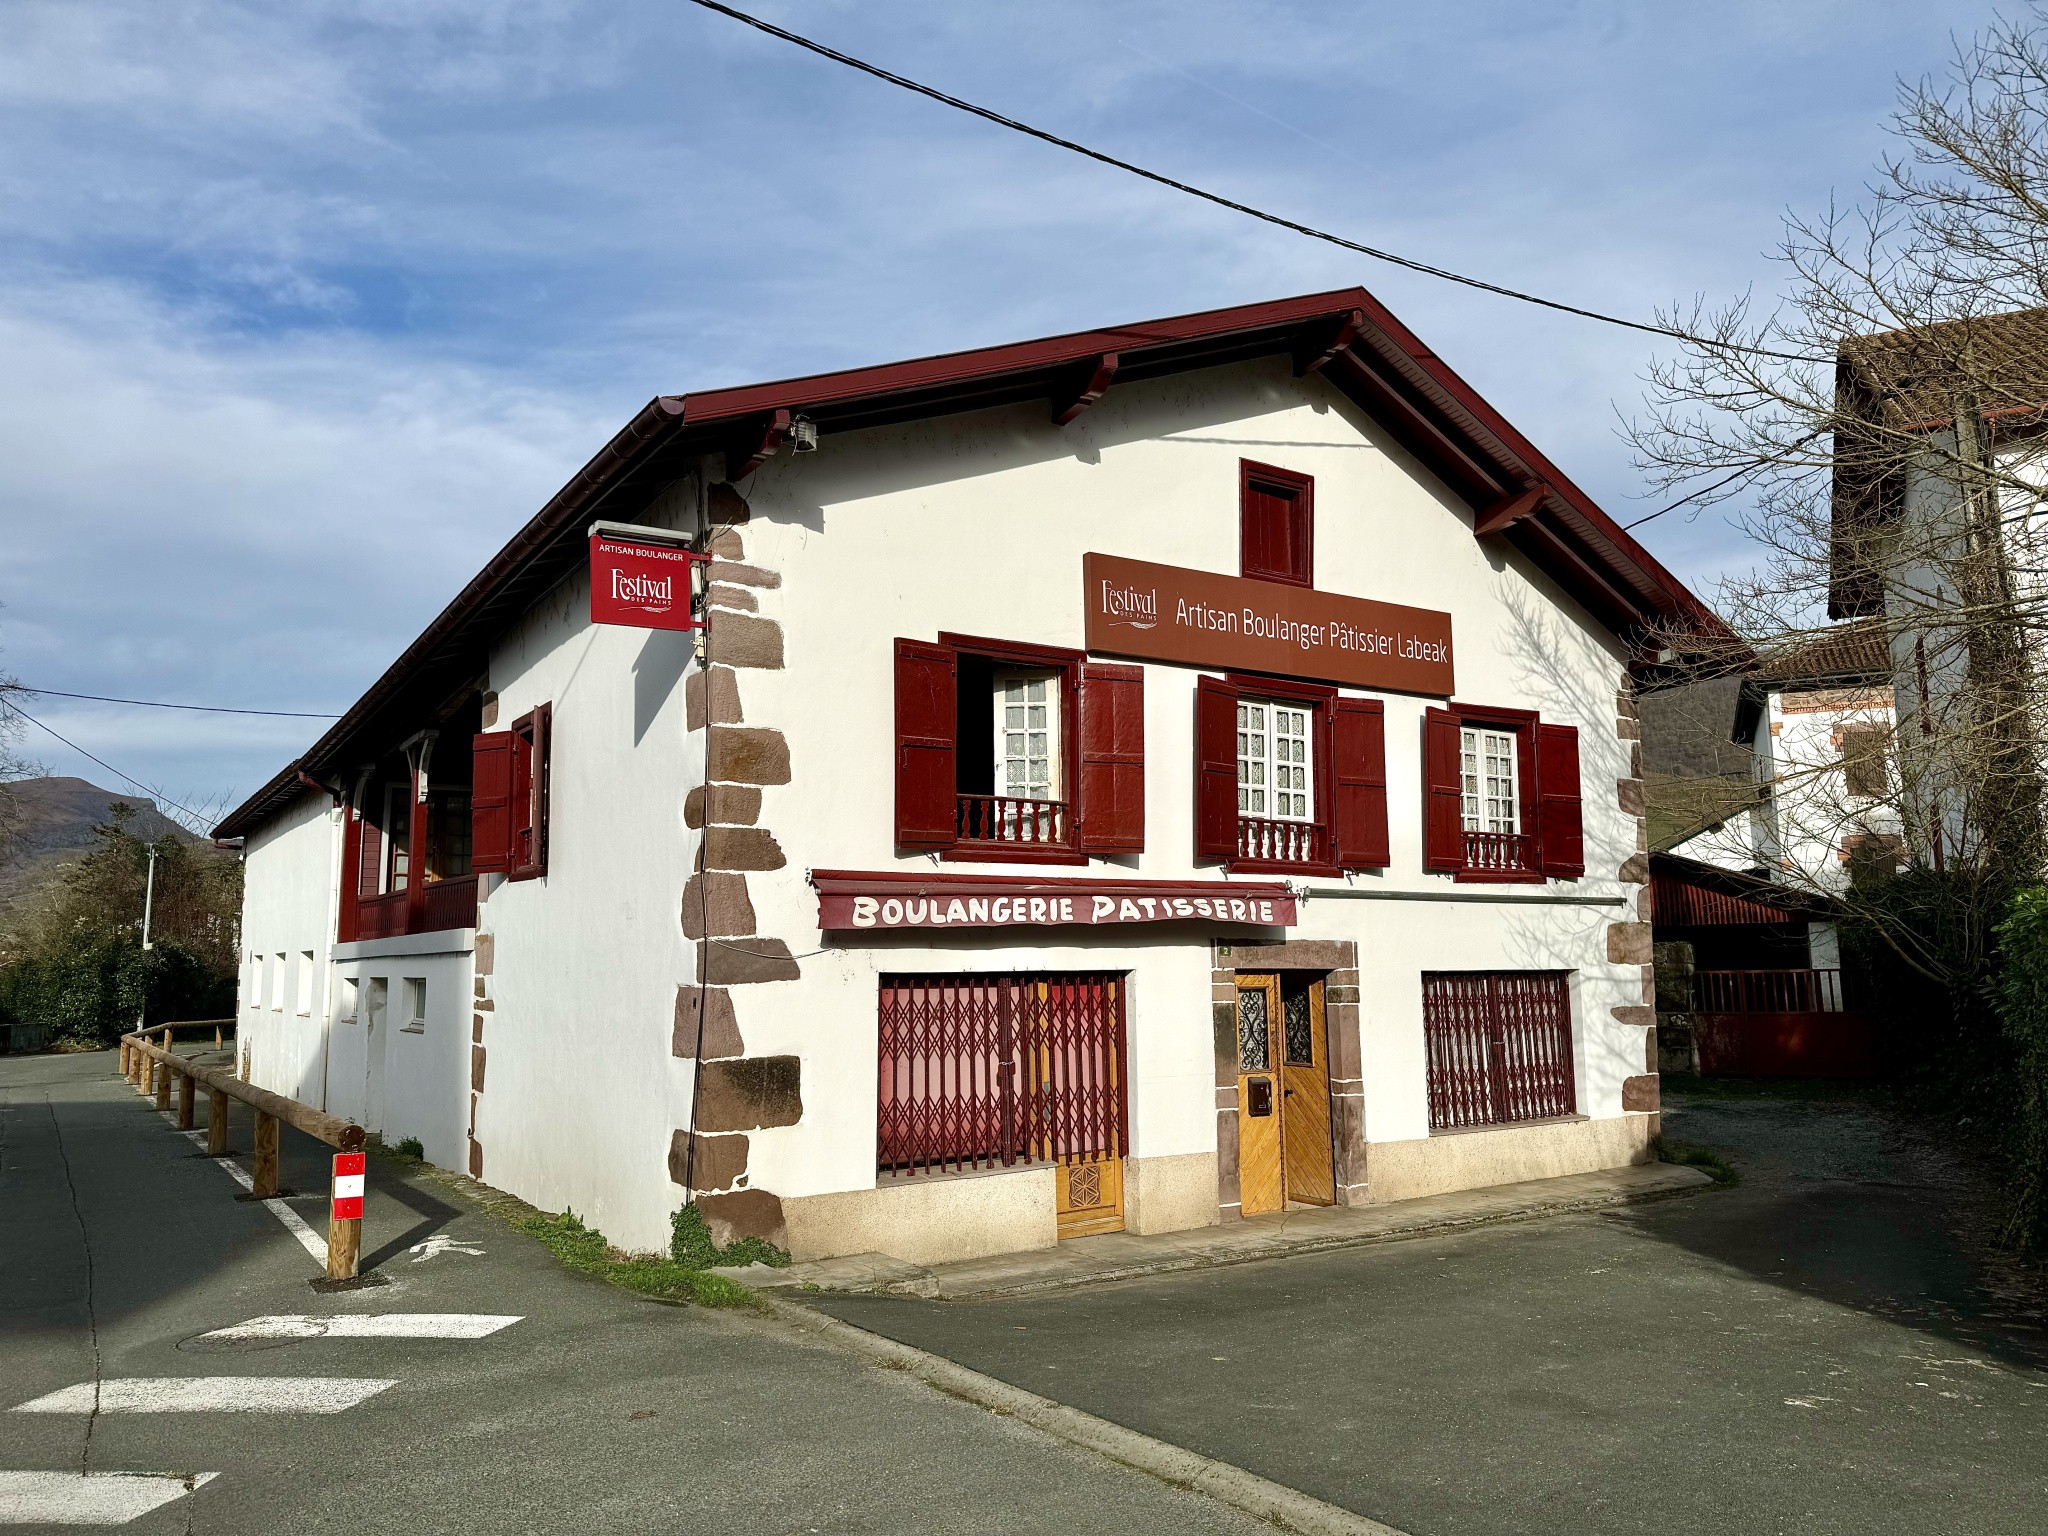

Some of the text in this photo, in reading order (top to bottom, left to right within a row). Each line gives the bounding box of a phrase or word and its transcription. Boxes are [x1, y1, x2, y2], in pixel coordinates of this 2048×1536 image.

[599, 544, 684, 562] ARTISAN BOULANGER
[611, 568, 673, 600] Festival
[1101, 579, 1157, 615] Festival
[1176, 598, 1448, 664] Artisan Boulanger Pâtissier Labeak
[852, 895, 1274, 927] BOULANGERIE PATISSERIE
